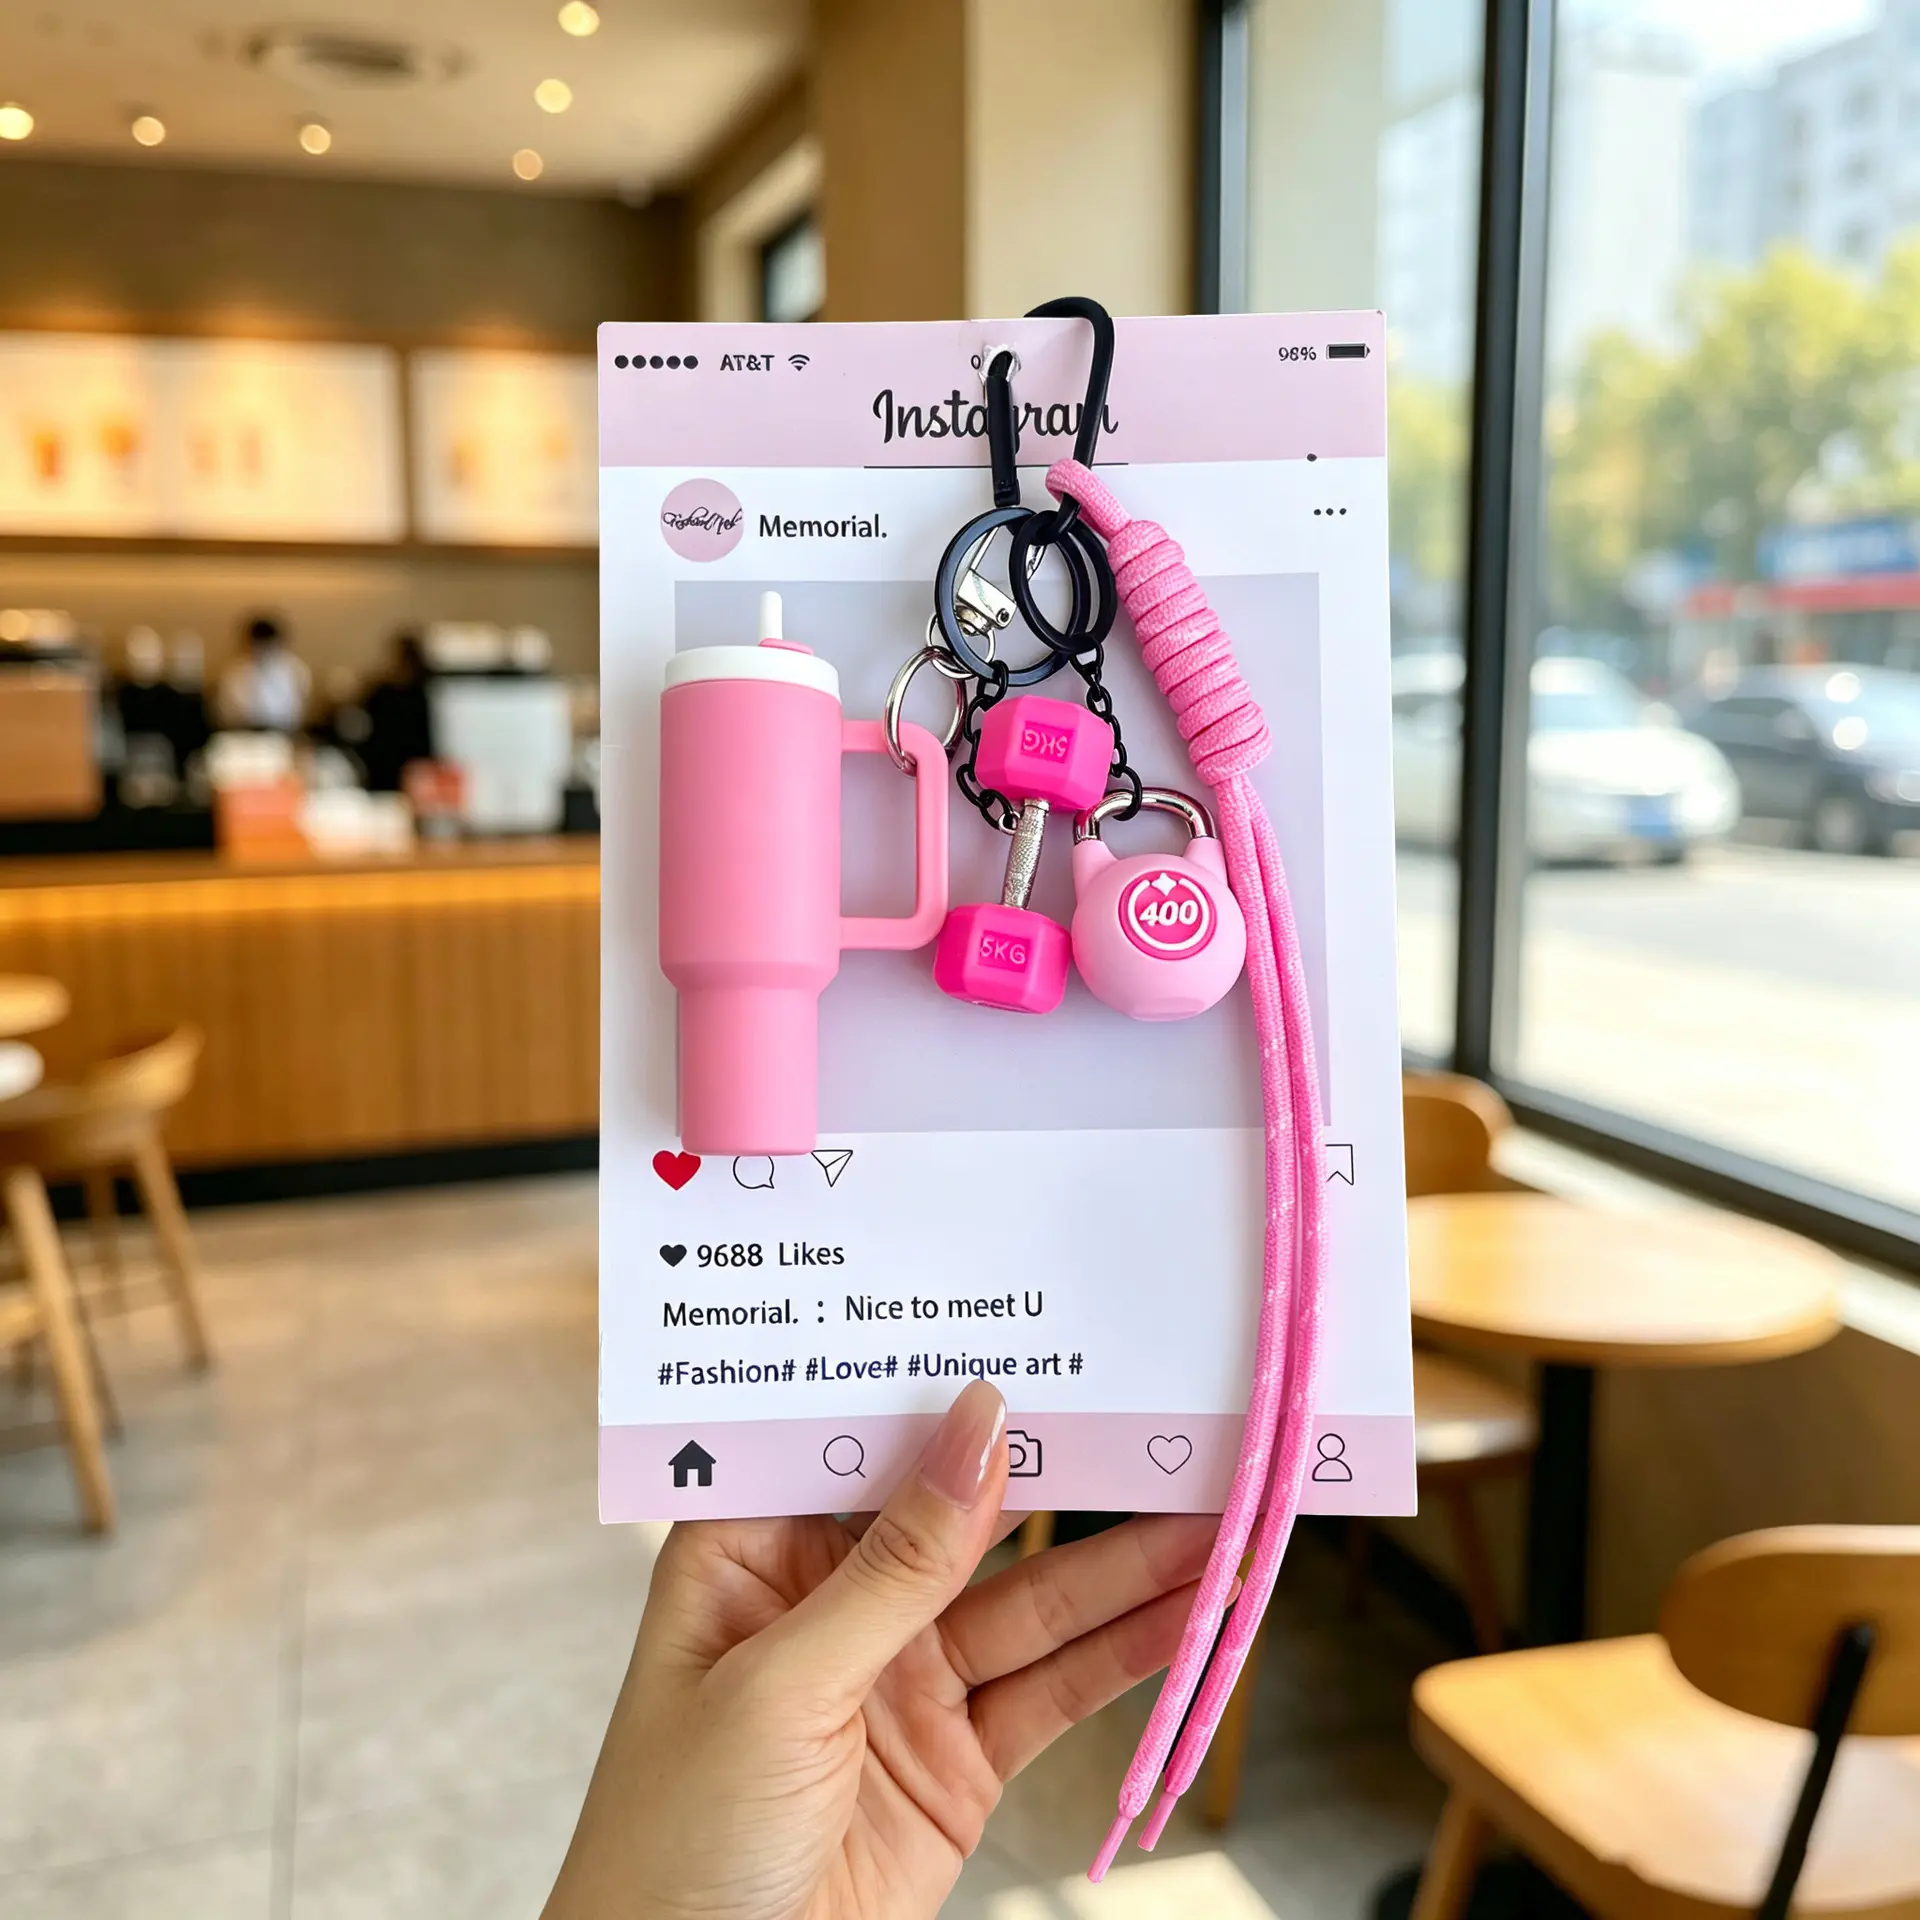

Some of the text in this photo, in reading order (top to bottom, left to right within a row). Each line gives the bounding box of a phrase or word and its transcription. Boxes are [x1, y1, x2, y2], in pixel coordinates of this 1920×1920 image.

[719, 353, 776, 372] AT&T
[1277, 346, 1318, 362] 98%
[872, 387, 1119, 456] Instara
[758, 513, 888, 539] Memorial.
[1139, 899, 1199, 928] 400
[980, 937, 1026, 965] 5KG
[696, 1241, 846, 1268] 9688 Likes
[662, 1298, 799, 1327] Memorial.
[845, 1294, 904, 1321] Nice
[910, 1296, 939, 1319] to
[947, 1293, 1016, 1318] meet
[1024, 1290, 1044, 1317] U
[657, 1358, 797, 1386] #Fashion#
[805, 1355, 899, 1382] #Love#
[907, 1352, 1018, 1381] #Unique
[1025, 1352, 1062, 1376] art
